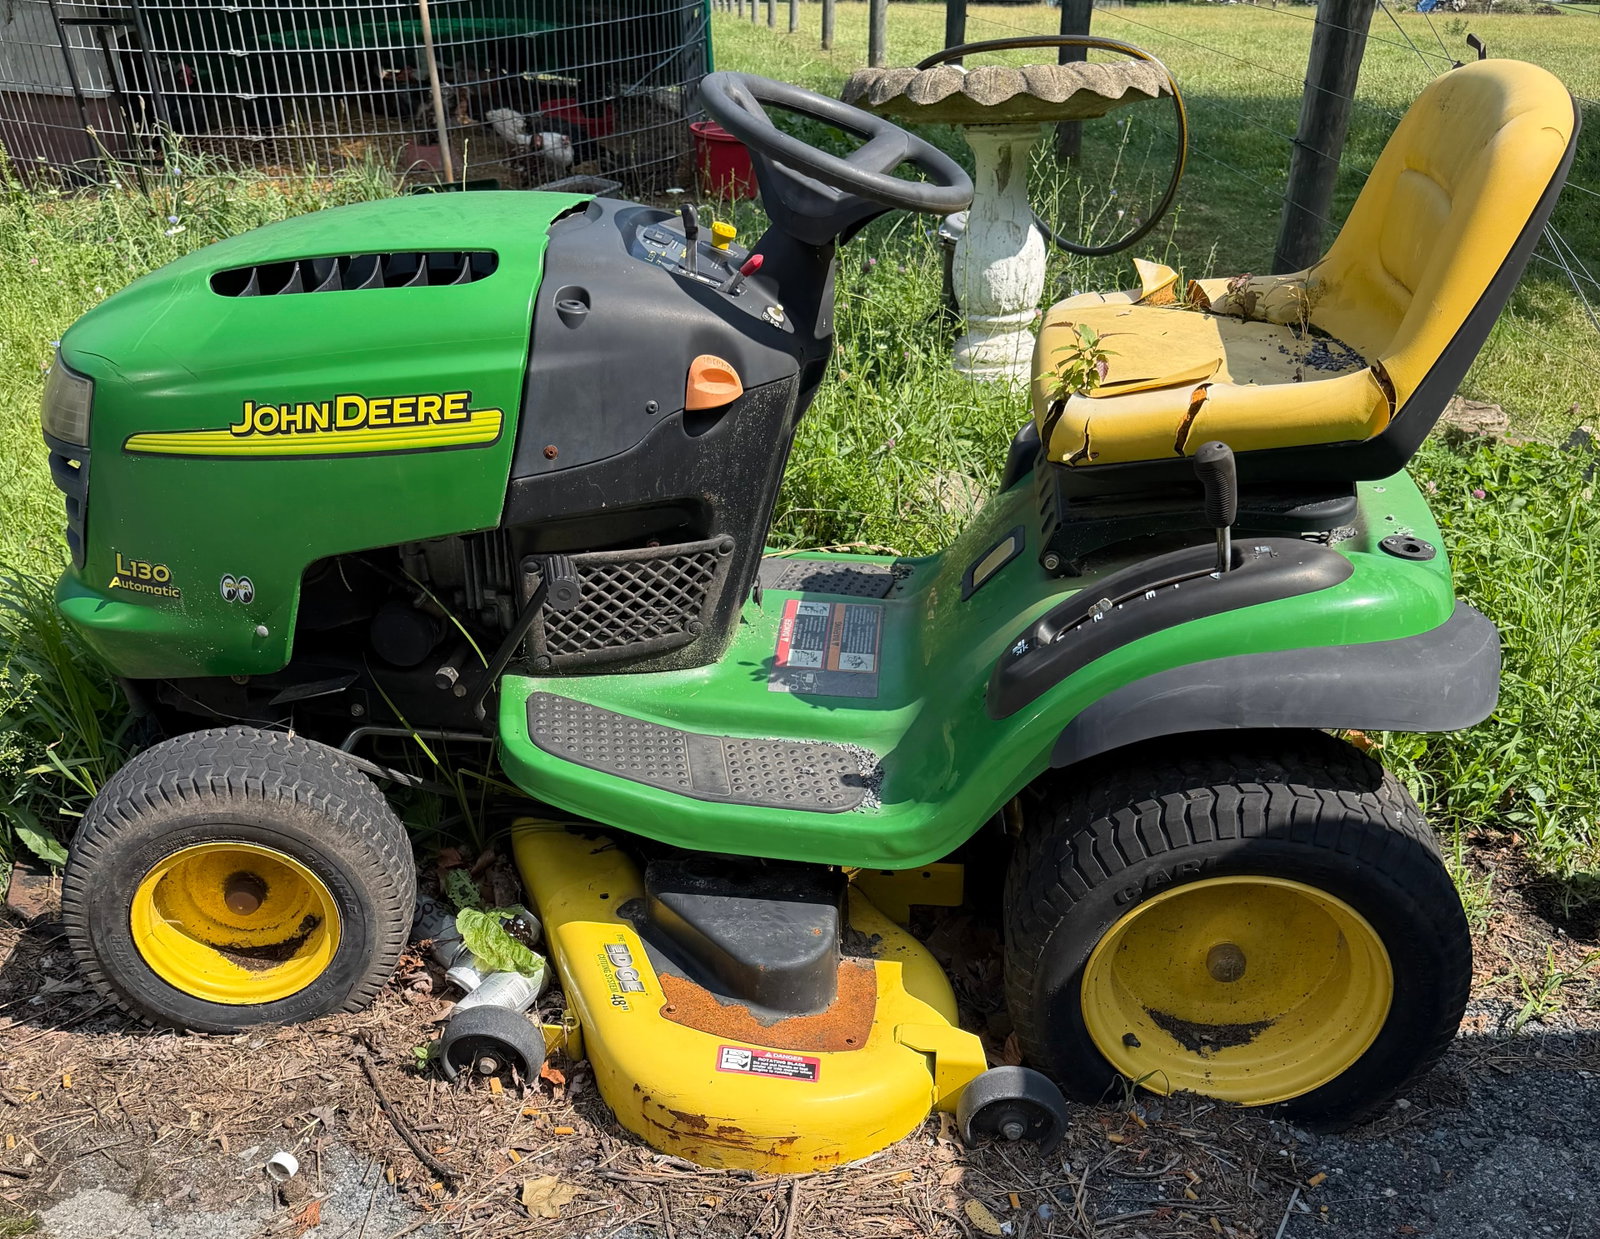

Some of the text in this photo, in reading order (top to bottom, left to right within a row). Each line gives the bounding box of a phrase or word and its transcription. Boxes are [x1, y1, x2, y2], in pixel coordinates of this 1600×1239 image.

[230, 391, 471, 436] JOHN DEERE
[115, 552, 171, 583] L130
[108, 577, 181, 599] Automatic
[1093, 611, 1104, 623] 2
[1145, 590, 1156, 600] 3
[604, 943, 646, 993] EDGE
[773, 1052, 804, 1062] DANGER
